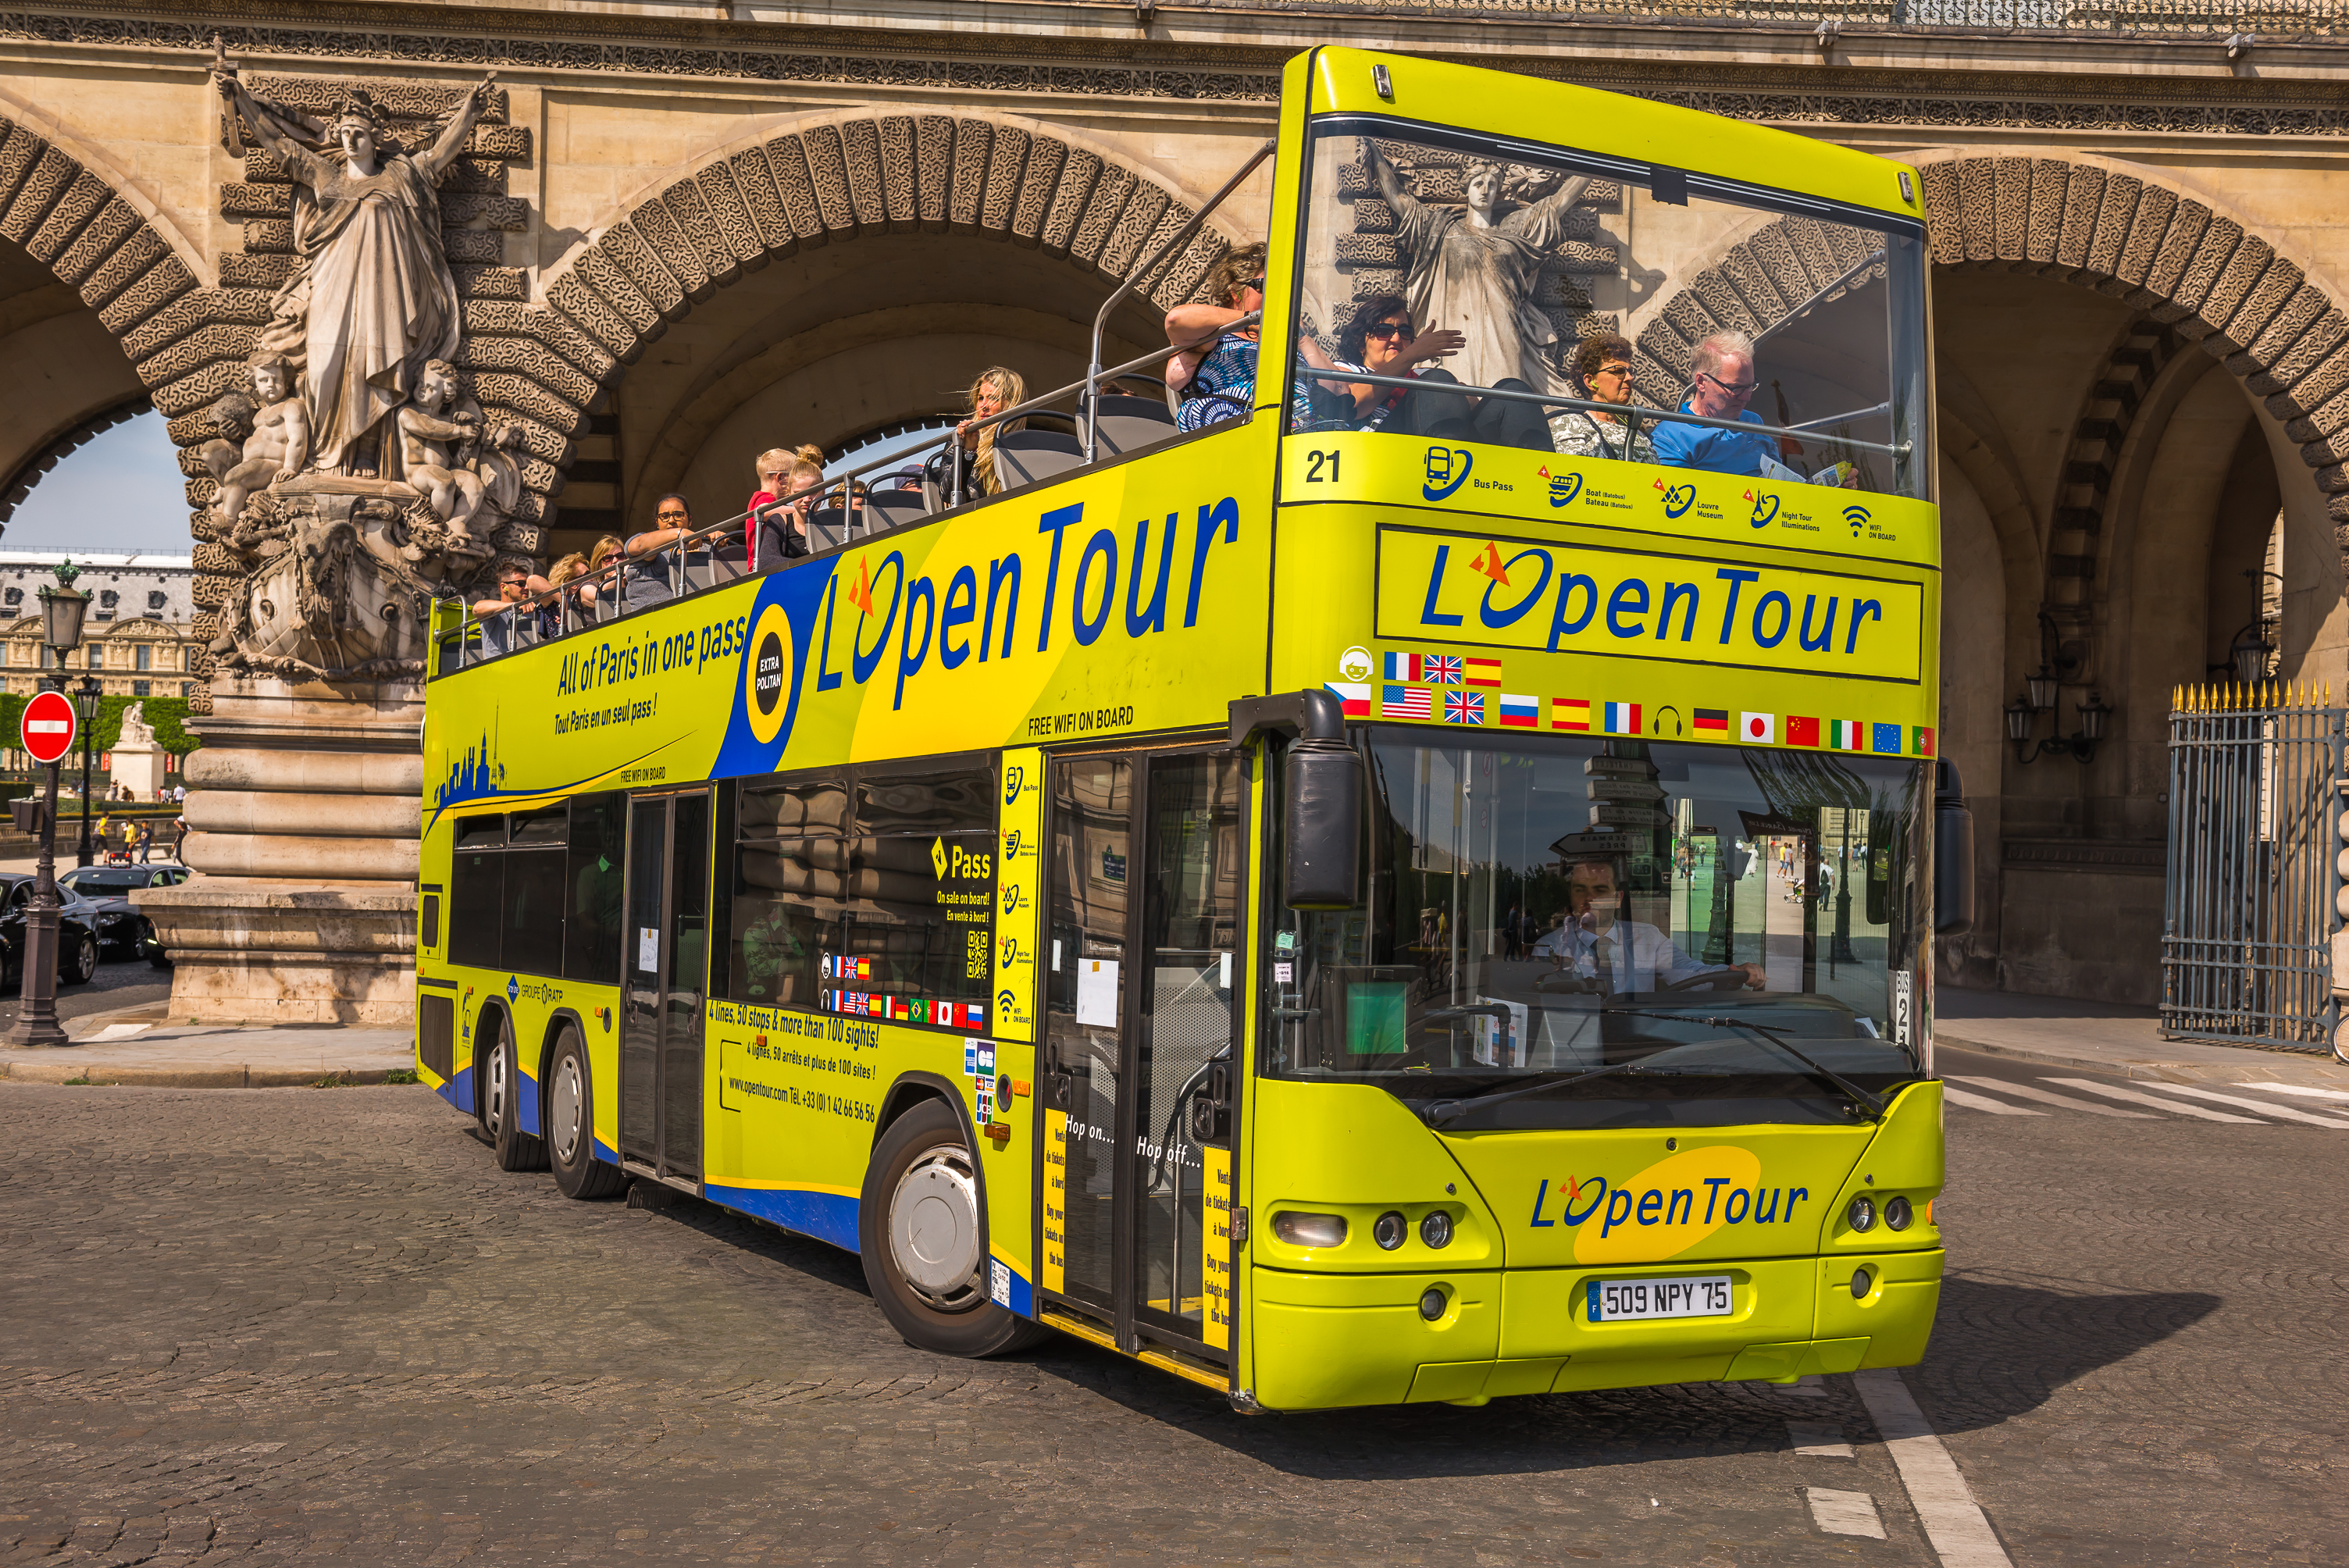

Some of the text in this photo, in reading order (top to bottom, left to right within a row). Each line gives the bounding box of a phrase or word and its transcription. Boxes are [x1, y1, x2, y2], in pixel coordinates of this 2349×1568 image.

[1306, 450, 1340, 483] 21
[1474, 479, 1513, 492] Bus Pass
[1585, 498, 1609, 507] Bateau
[1698, 501, 1719, 511] Louvre
[1697, 510, 1723, 520] Museum
[1782, 511, 1798, 522] Night
[1782, 521, 1820, 532] Illuminations
[1877, 533, 1896, 541] BOARD
[558, 616, 745, 697] All of Paris in one pass
[760, 656, 779, 672] EXTRA
[757, 673, 781, 690] POLITAN
[554, 714, 569, 735] Tout
[570, 707, 588, 732] Paris
[590, 712, 600, 728] en
[601, 710, 611, 726] un
[613, 698, 629, 723] seul
[631, 699, 651, 726] pass
[1028, 706, 1133, 737] FREE WIFI ON BOARD
[621, 766, 665, 783] FREE WIFI ON BOARD
[952, 846, 990, 878] Pass
[937, 891, 989, 905] On sale on board!
[947, 910, 954, 921] En
[954, 911, 968, 921] vente
[969, 911, 972, 921] à
[974, 911, 986, 922] bord
[1898, 972, 1909, 993] BUS
[522, 985, 540, 1000] GROUPE
[548, 989, 562, 1003] RATP
[709, 1000, 879, 1051] 4 lines, 50 stops & more than 100 sights!
[747, 1042, 750, 1054] 4
[752, 1042, 772, 1060] lignes,
[773, 1046, 781, 1060] 50
[782, 1049, 801, 1065] arrêts
[804, 1054, 810, 1067] et
[811, 1054, 826, 1071] plus
[828, 1057, 836, 1072] de
[839, 1059, 851, 1075] 100
[853, 1062, 871, 1079] sites
[978, 1050, 993, 1067] CB
[729, 1077, 875, 1123] www.opentour.com Tél. +33 (0) 1 42 66 56 56
[977, 1103, 992, 1115] JCB
[1055, 1128, 1065, 1142] Vente
[1064, 1114, 1114, 1143] Hop on...
[1046, 1150, 1064, 1166] de tickets
[1136, 1135, 1200, 1168] Hop off...
[1052, 1175, 1064, 1189] à bord
[1206, 1193, 1230, 1212] de tickets
[1054, 1210, 1064, 1221] your
[1045, 1227, 1064, 1244] tickets on
[1214, 1223, 1217, 1235] à
[1207, 1254, 1230, 1273] Buy your
[1205, 1280, 1222, 1299] tickets
[1607, 1282, 1727, 1314] 509 NPY 75
[1211, 1307, 1230, 1326] the bus
[1592, 1305, 1597, 1313] F
